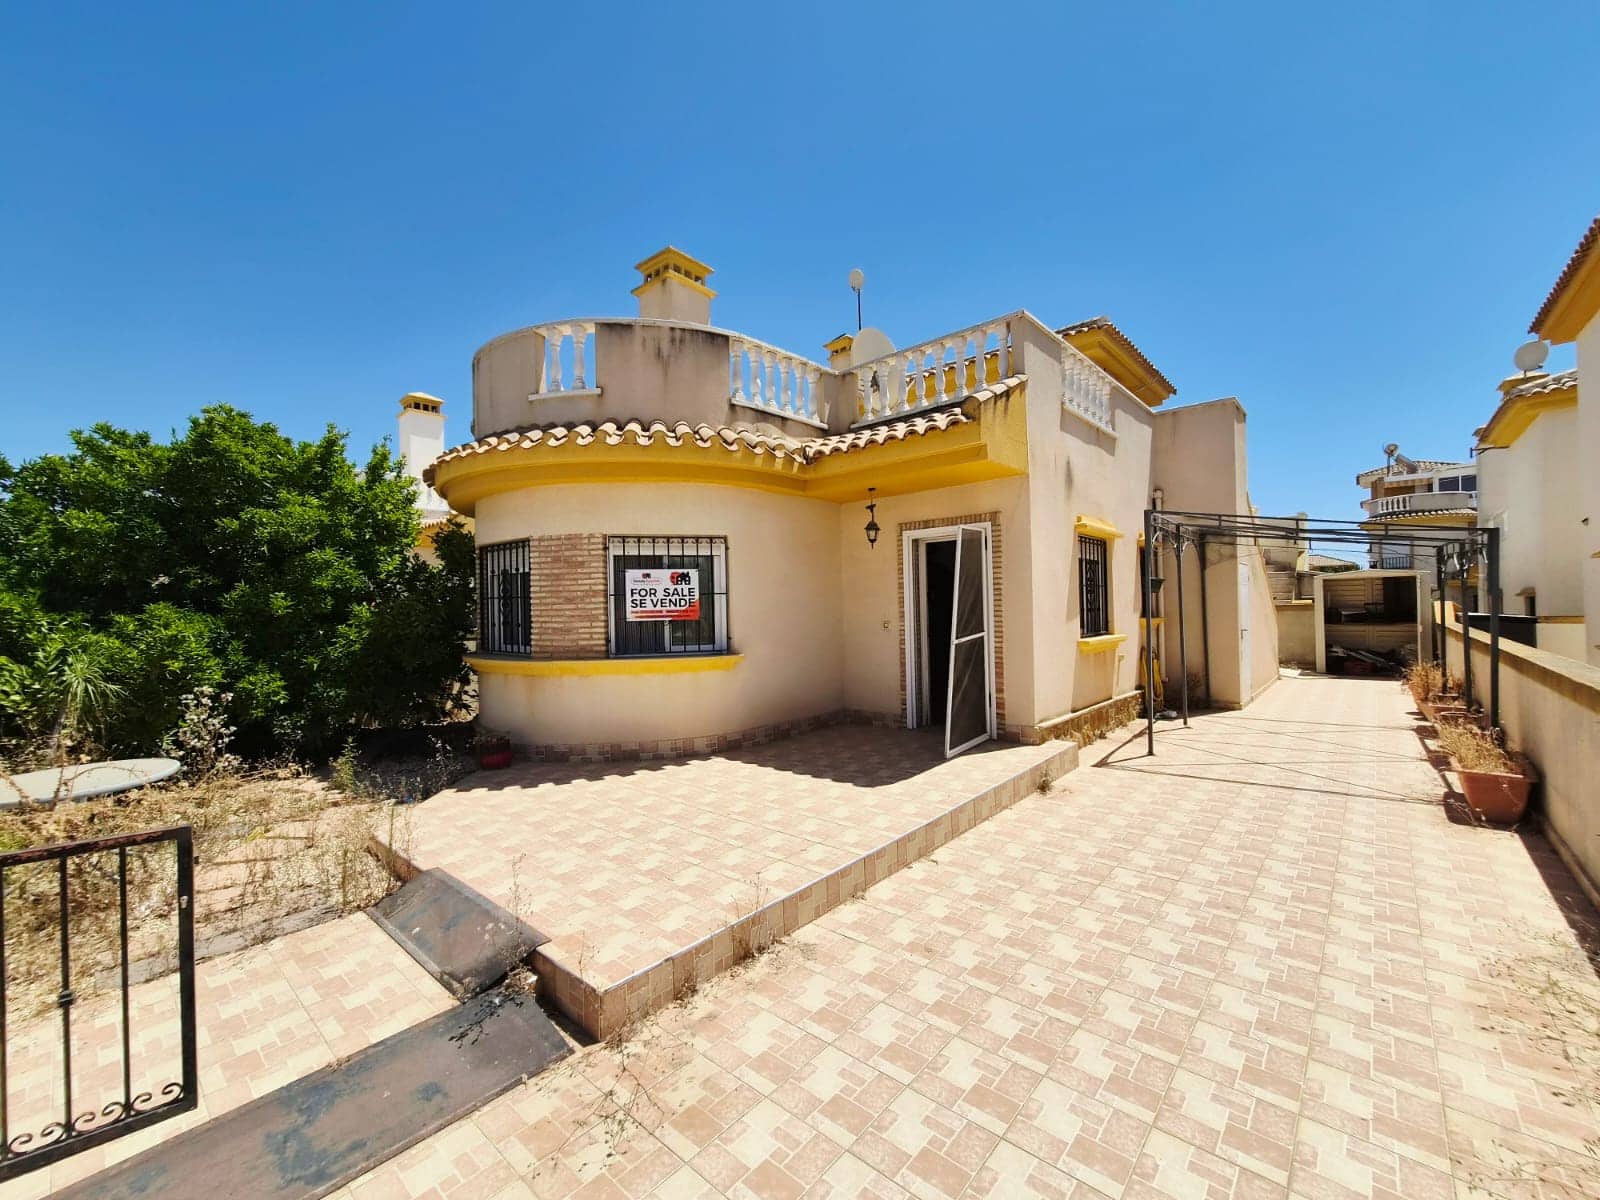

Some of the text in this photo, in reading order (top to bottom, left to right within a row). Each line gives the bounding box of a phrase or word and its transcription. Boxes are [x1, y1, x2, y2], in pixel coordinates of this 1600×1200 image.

[631, 588, 695, 598] FOR SALE
[631, 598, 696, 608] SE VENDE
